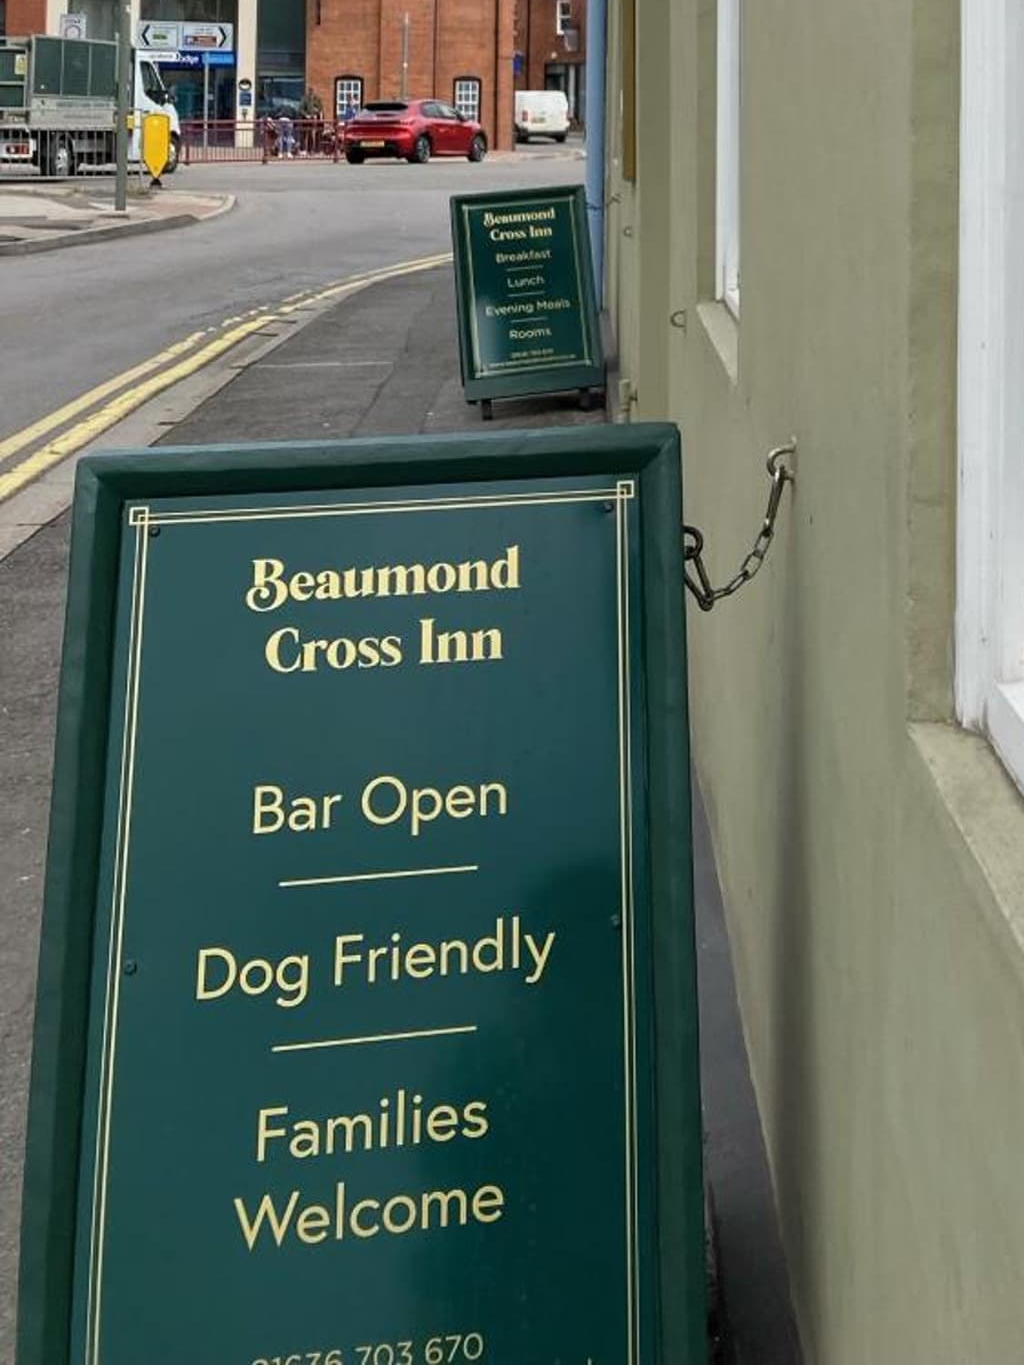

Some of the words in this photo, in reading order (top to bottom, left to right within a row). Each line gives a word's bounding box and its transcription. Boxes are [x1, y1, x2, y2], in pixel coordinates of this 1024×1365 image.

[484, 207, 555, 227] Beaumond
[490, 229, 527, 242] Cross
[529, 225, 553, 238] Inn
[496, 250, 551, 264] Breakfast
[507, 275, 545, 288] Lunch
[485, 303, 534, 317] Evening
[537, 298, 570, 310] Meals
[509, 327, 552, 339] Rooms
[245, 545, 521, 612] Beaumond
[265, 627, 402, 673] Cross
[419, 618, 504, 664] Inn
[253, 785, 342, 834] Bar
[361, 775, 507, 836] Open
[196, 947, 309, 1008] Dog
[334, 916, 556, 986] Friendly
[257, 1089, 489, 1162] Families
[233, 1182, 505, 1251] Welcome
[355, 1341, 413, 1365] 703
[424, 1332, 484, 1364] 670
